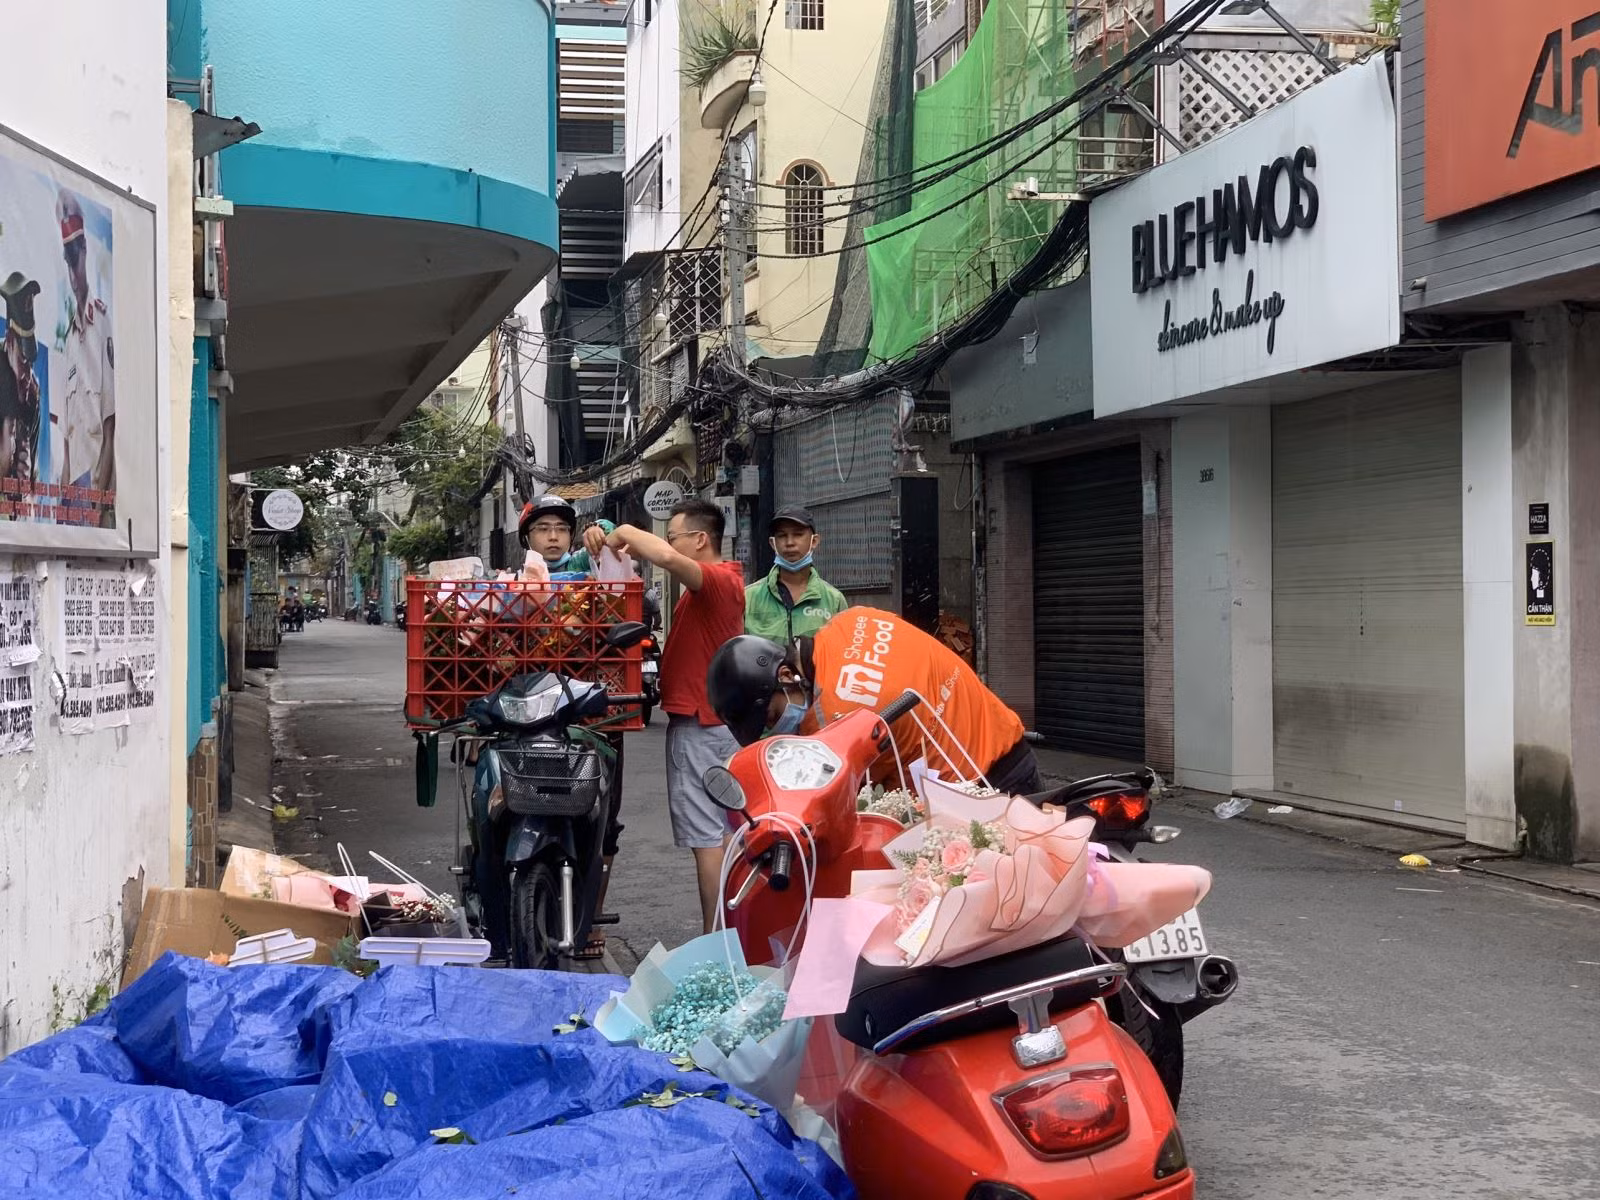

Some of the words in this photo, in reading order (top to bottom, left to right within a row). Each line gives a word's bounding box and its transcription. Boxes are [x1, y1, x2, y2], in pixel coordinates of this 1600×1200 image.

[1132, 145, 1320, 294] BLUEHAMOS
[1157, 299, 1209, 352] skincare
[1209, 287, 1223, 337] &
[1224, 269, 1262, 330] make
[1262, 290, 1286, 355] up
[844, 616, 868, 660] Shopee
[864, 618, 894, 668] Food
